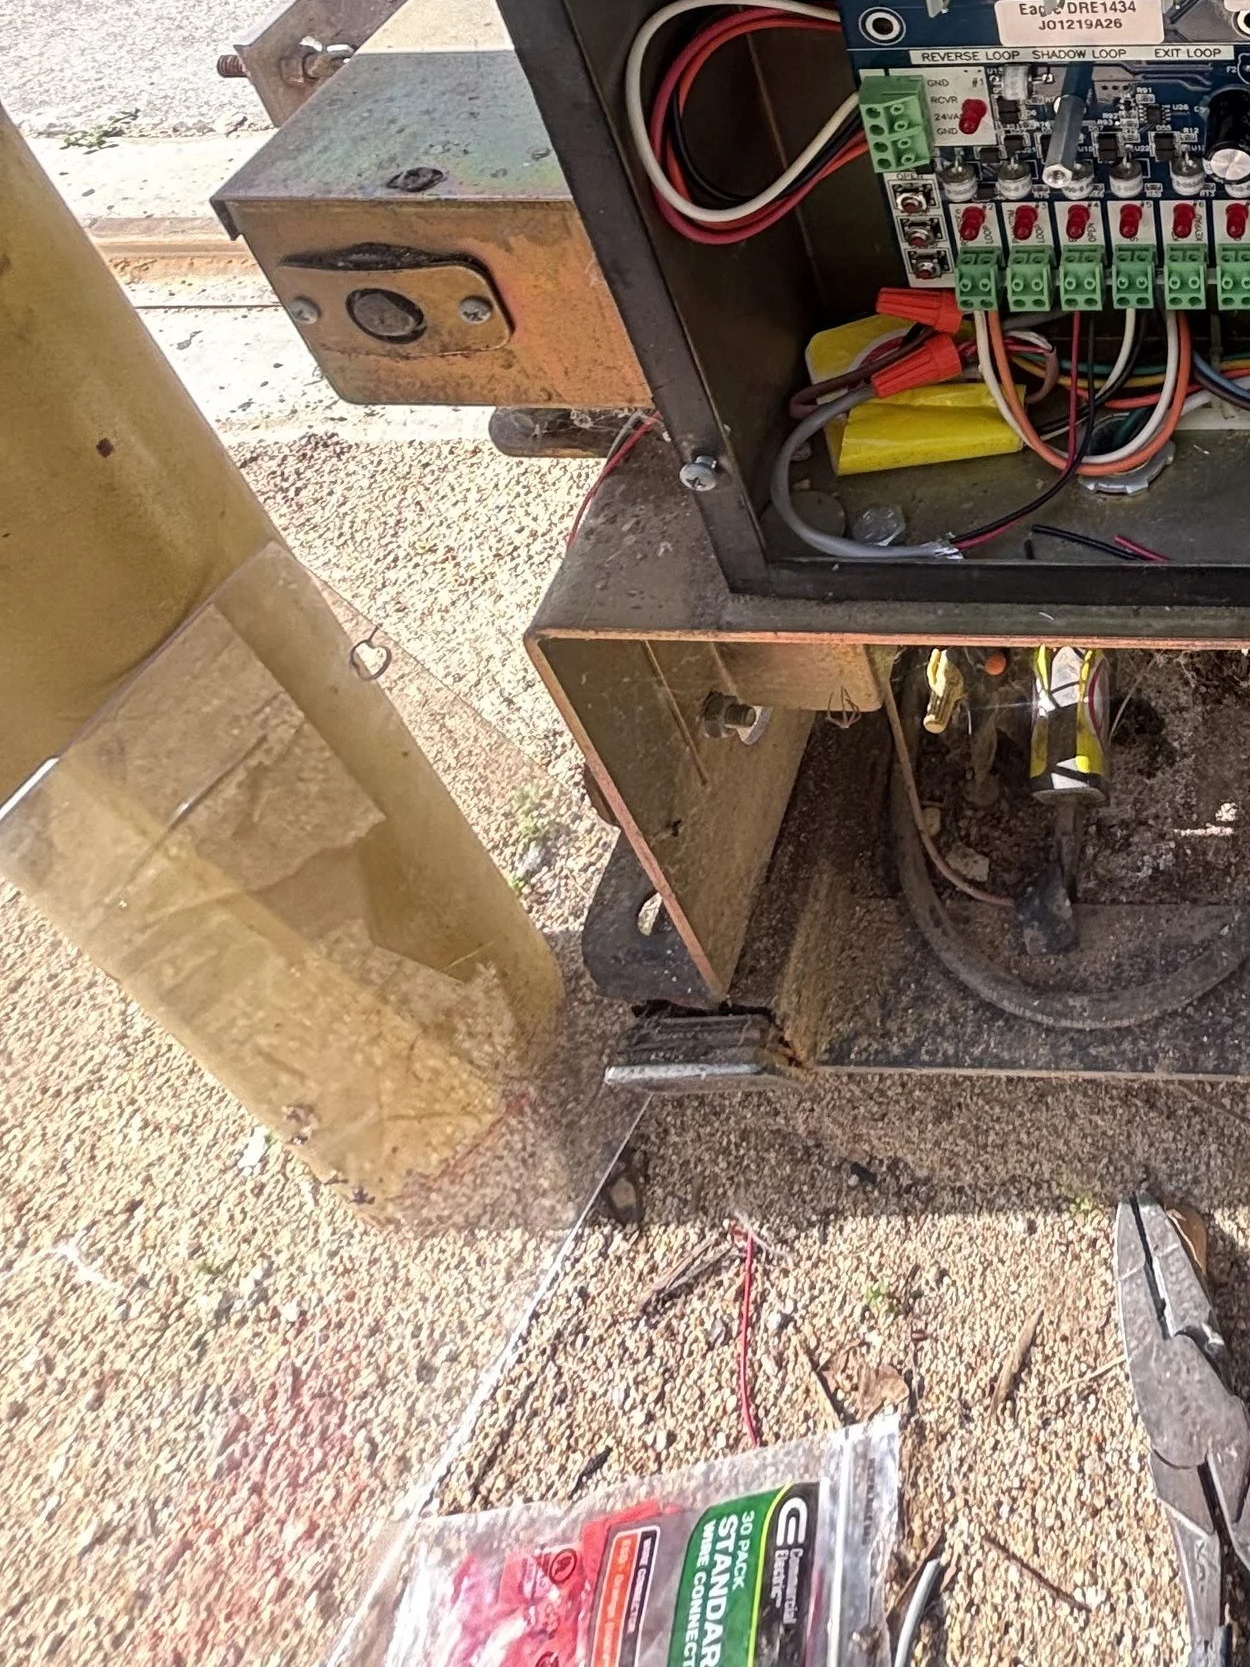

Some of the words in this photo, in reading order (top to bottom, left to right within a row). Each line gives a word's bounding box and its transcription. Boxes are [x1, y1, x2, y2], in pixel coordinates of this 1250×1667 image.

[1019, 4, 1062, 16] Eage
[1068, 0, 1136, 14] DRE1434
[921, 51, 980, 62] REVERSE
[984, 51, 1020, 61] LOOP
[1032, 49, 1086, 59] SHADOW
[1092, 48, 1127, 59] LOOP
[1154, 48, 1183, 58] EXIT
[1187, 48, 1221, 58] LOOP
[931, 96, 958, 104] RCVR
[740, 1510, 755, 1535] 30
[696, 1519, 717, 1568] WIRE
[732, 1541, 749, 1590] PACK
